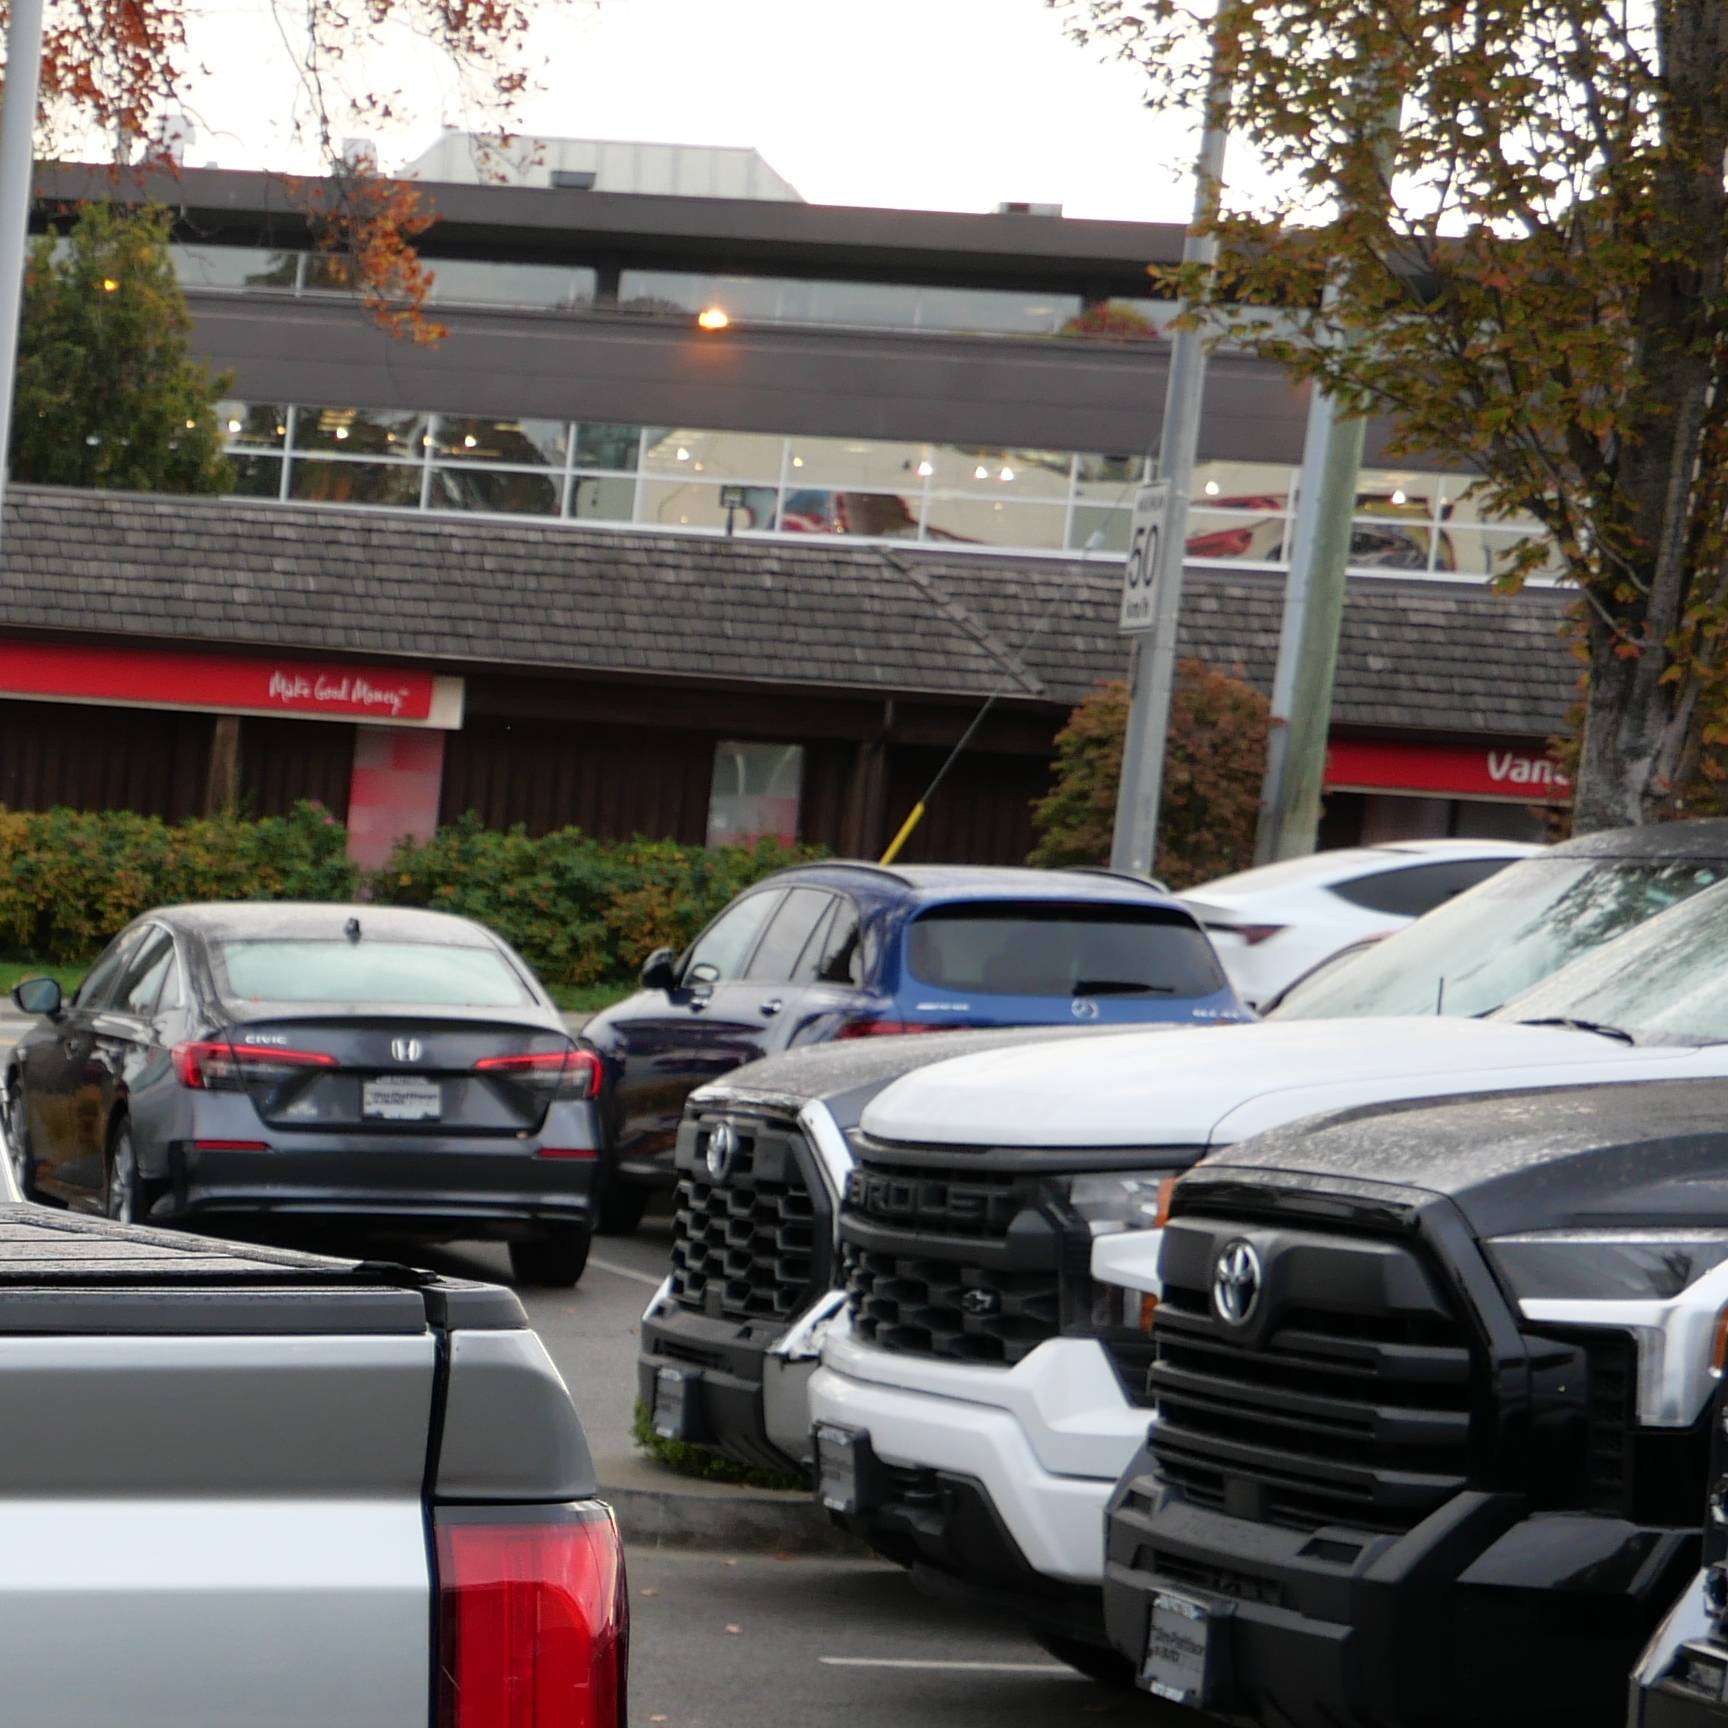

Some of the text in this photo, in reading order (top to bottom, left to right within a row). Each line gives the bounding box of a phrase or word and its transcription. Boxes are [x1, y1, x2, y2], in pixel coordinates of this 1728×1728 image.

[1128, 524, 1159, 589] 50
[269, 670, 310, 703] Make
[314, 675, 349, 701] Good
[245, 1033, 287, 1045] CIVIC
